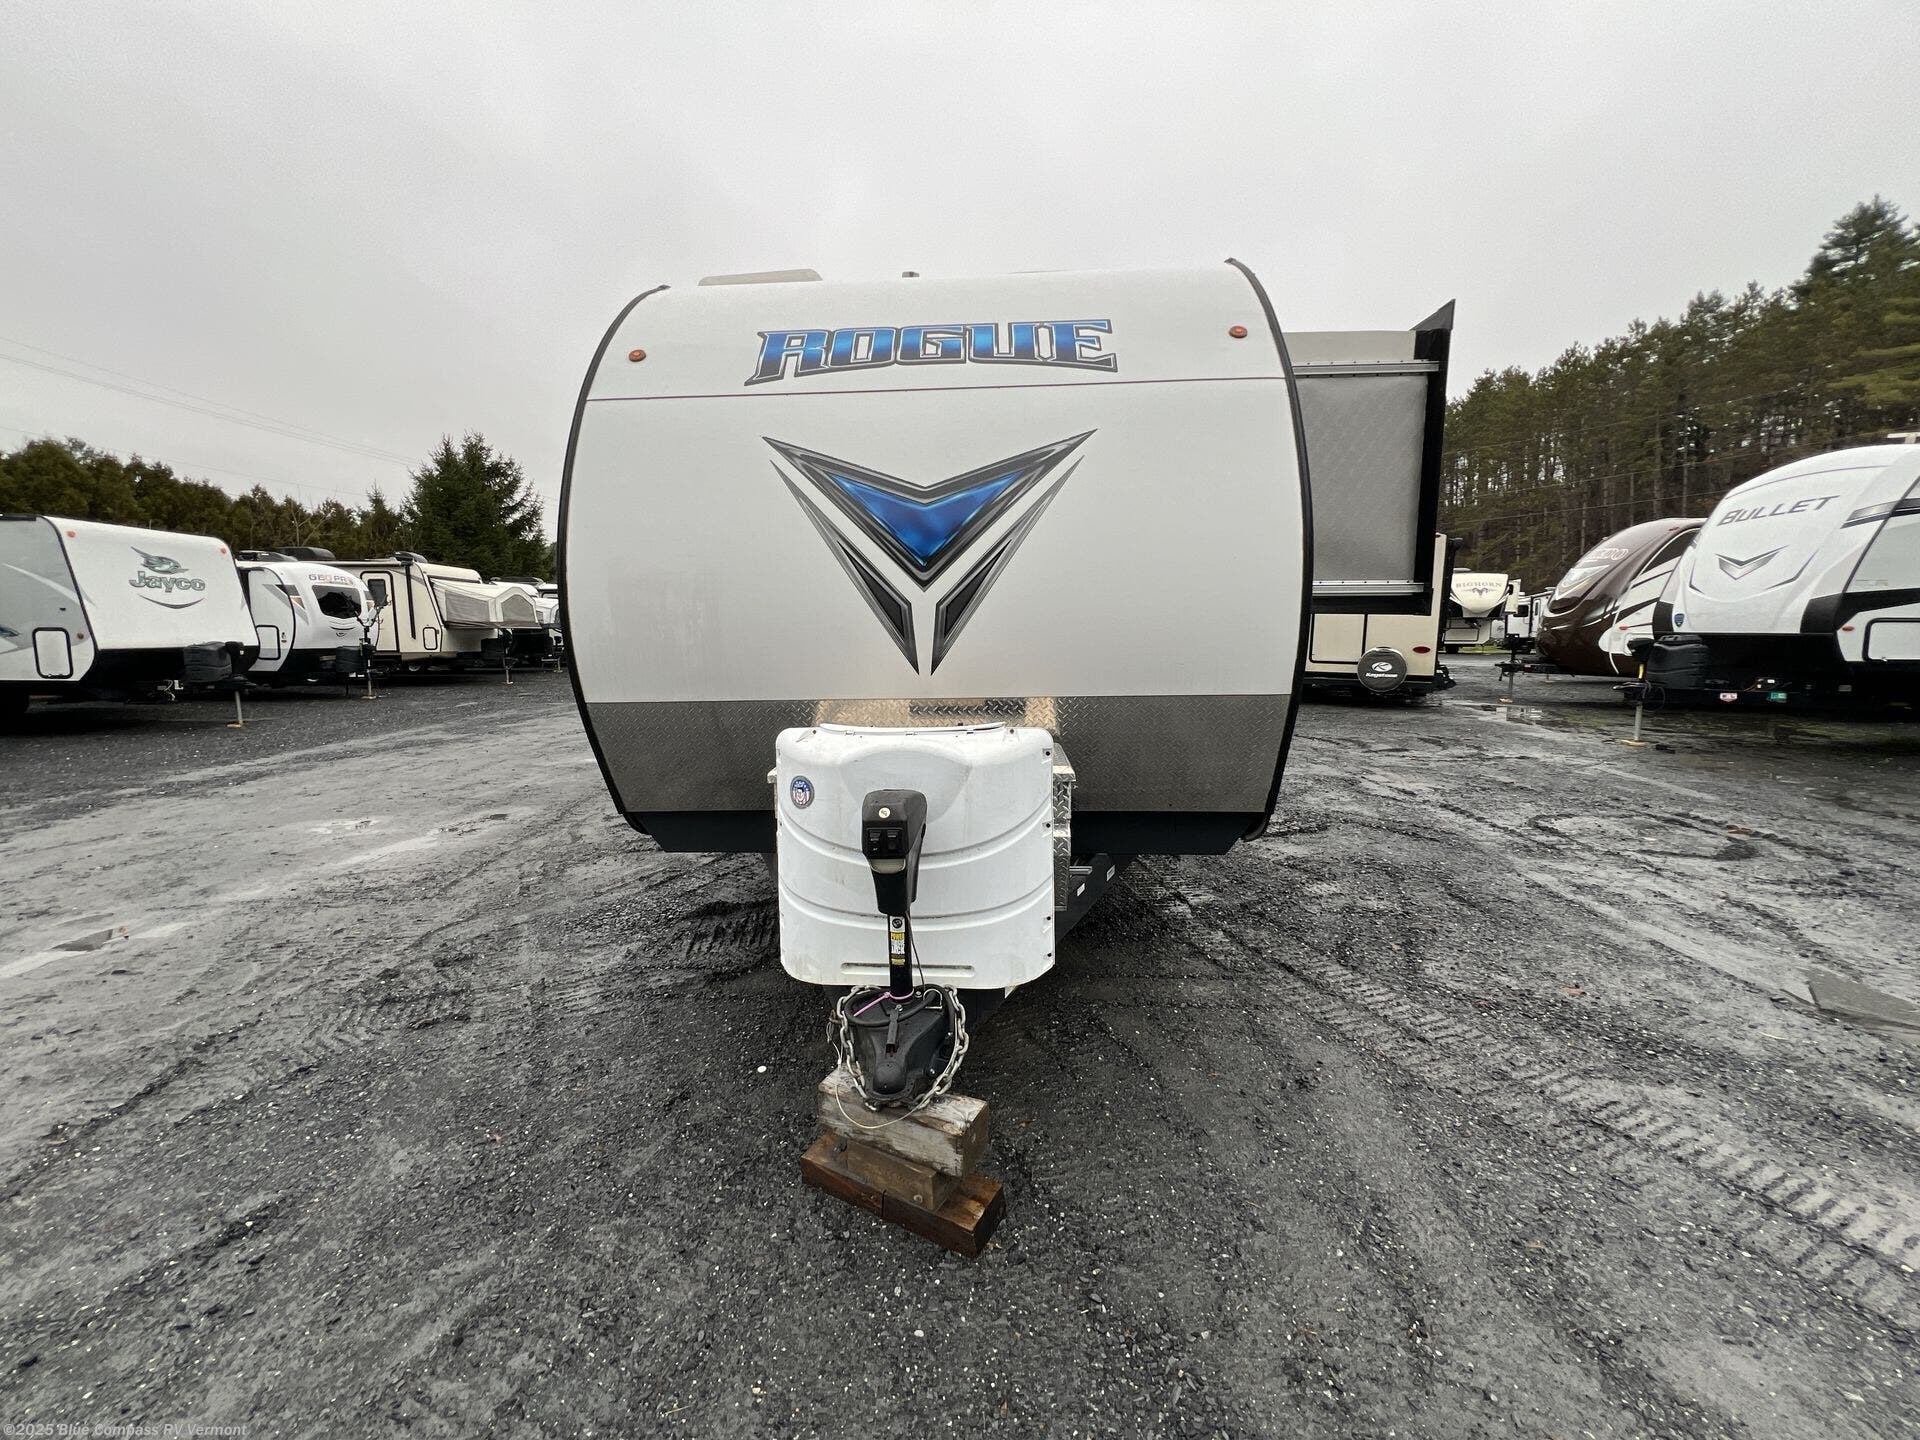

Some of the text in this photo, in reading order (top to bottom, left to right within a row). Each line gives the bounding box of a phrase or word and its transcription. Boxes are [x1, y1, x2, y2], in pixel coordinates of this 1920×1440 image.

[744, 318, 1119, 386] ROGUE
[1717, 494, 1841, 527] BULLET
[128, 570, 206, 593] Jayco
